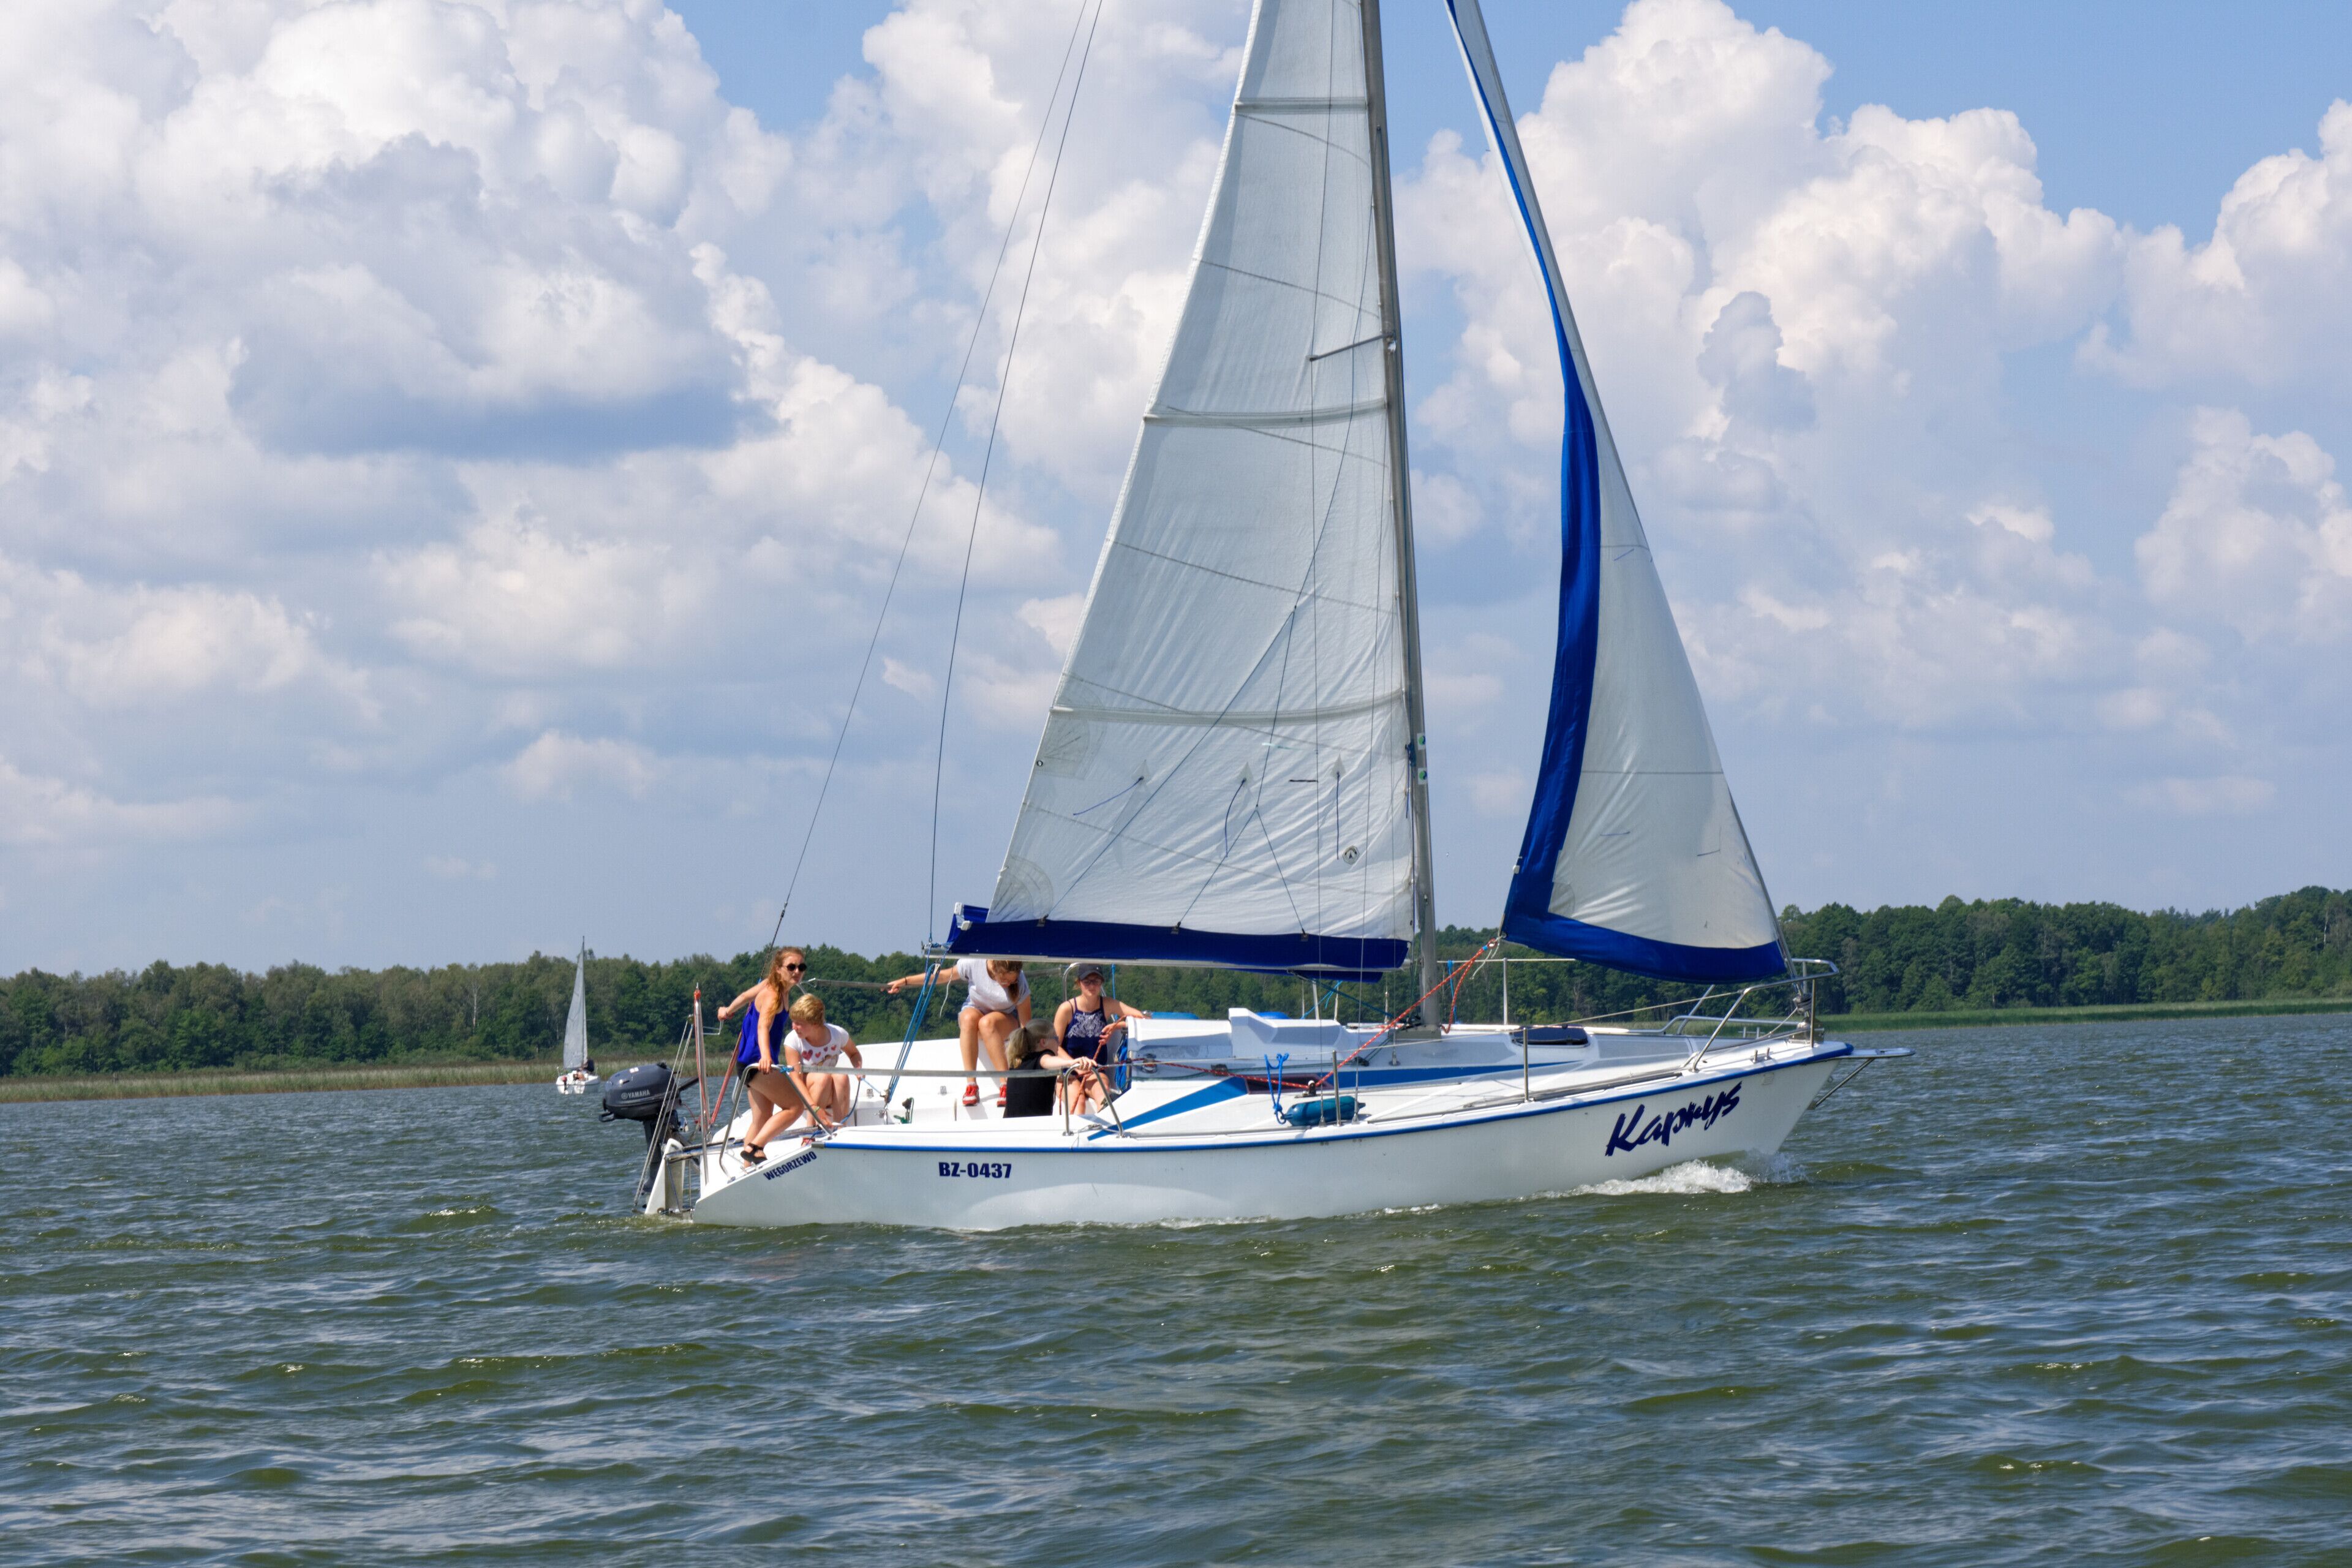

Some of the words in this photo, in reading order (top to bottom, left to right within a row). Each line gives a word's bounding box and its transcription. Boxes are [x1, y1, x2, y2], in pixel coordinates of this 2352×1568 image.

[628, 1090, 650, 1098] YAMAHA
[1605, 1081, 1741, 1156] Kaprys
[763, 1151, 817, 1180] WĘGORZEWO
[938, 1162, 1011, 1178] BZ-0437
